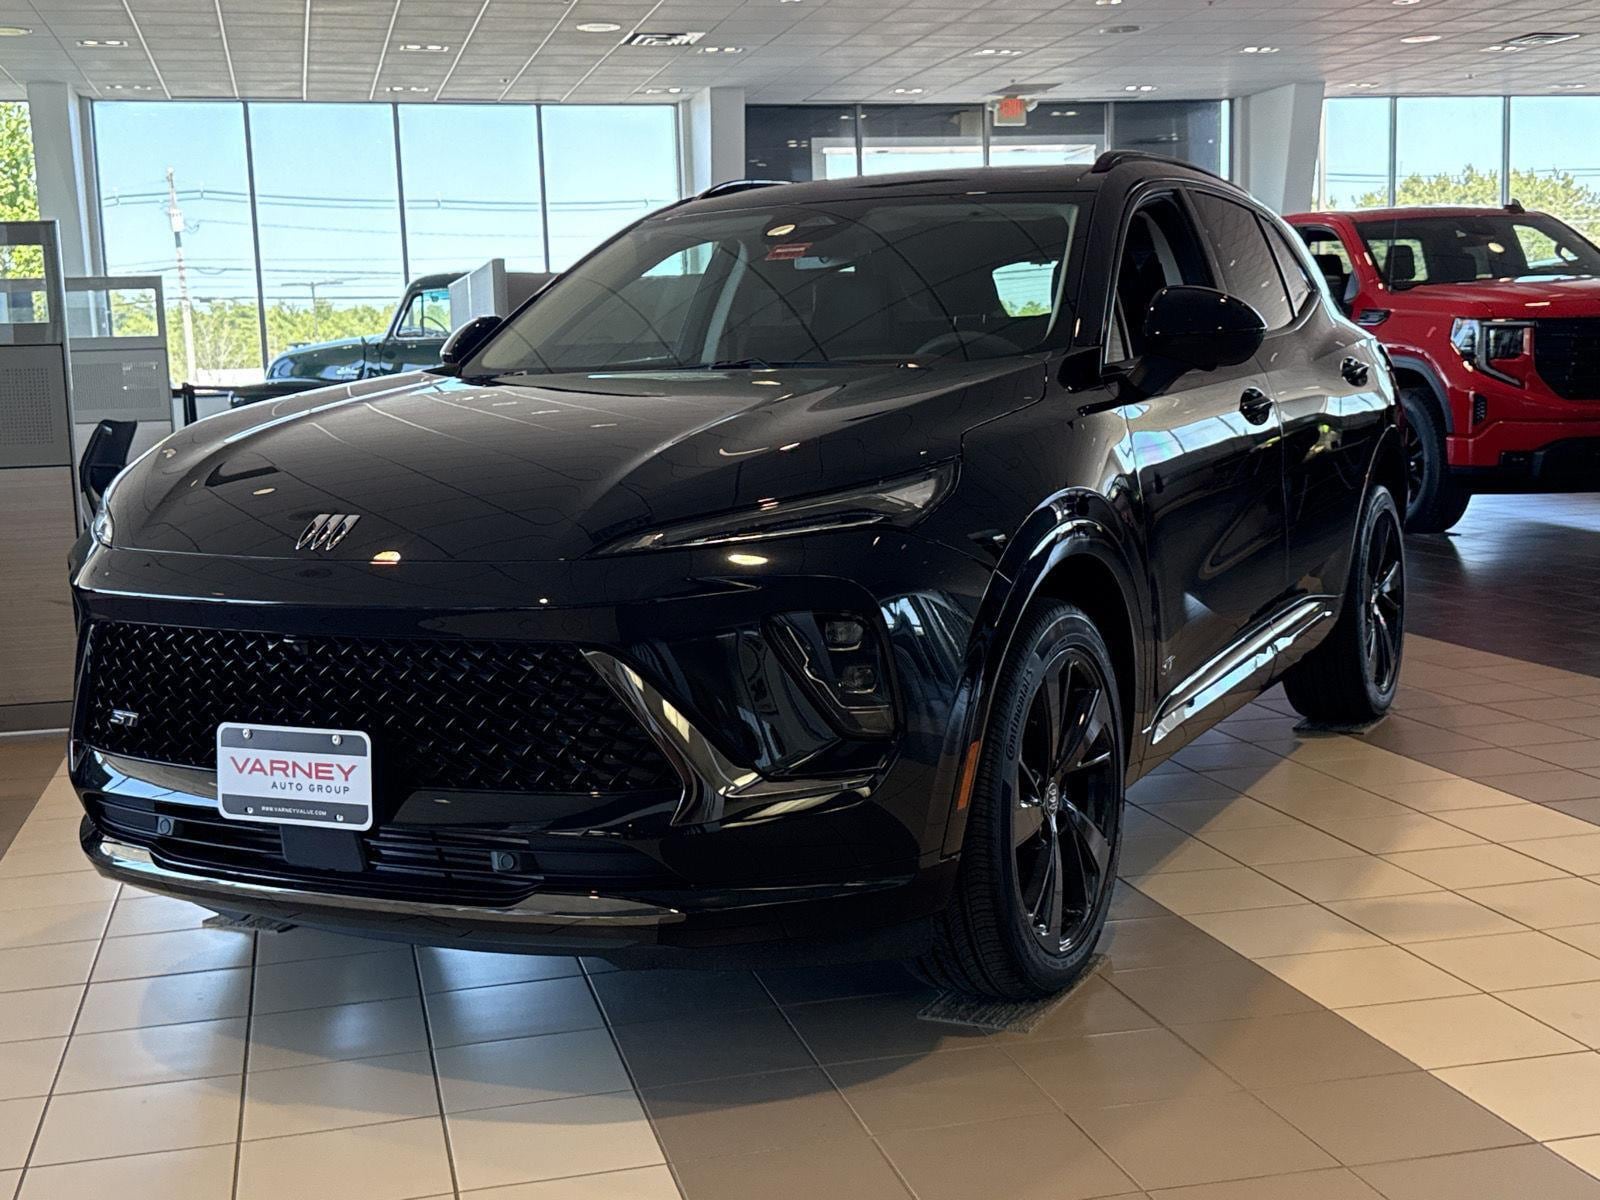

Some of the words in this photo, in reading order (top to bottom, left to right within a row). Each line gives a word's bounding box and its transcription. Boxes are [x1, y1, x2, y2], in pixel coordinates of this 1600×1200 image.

[110, 709, 139, 727] ST
[1006, 676, 1031, 760] Continental
[230, 756, 358, 782] VARNEY
[271, 781, 303, 792] AUTO
[309, 783, 350, 795] GROUP
